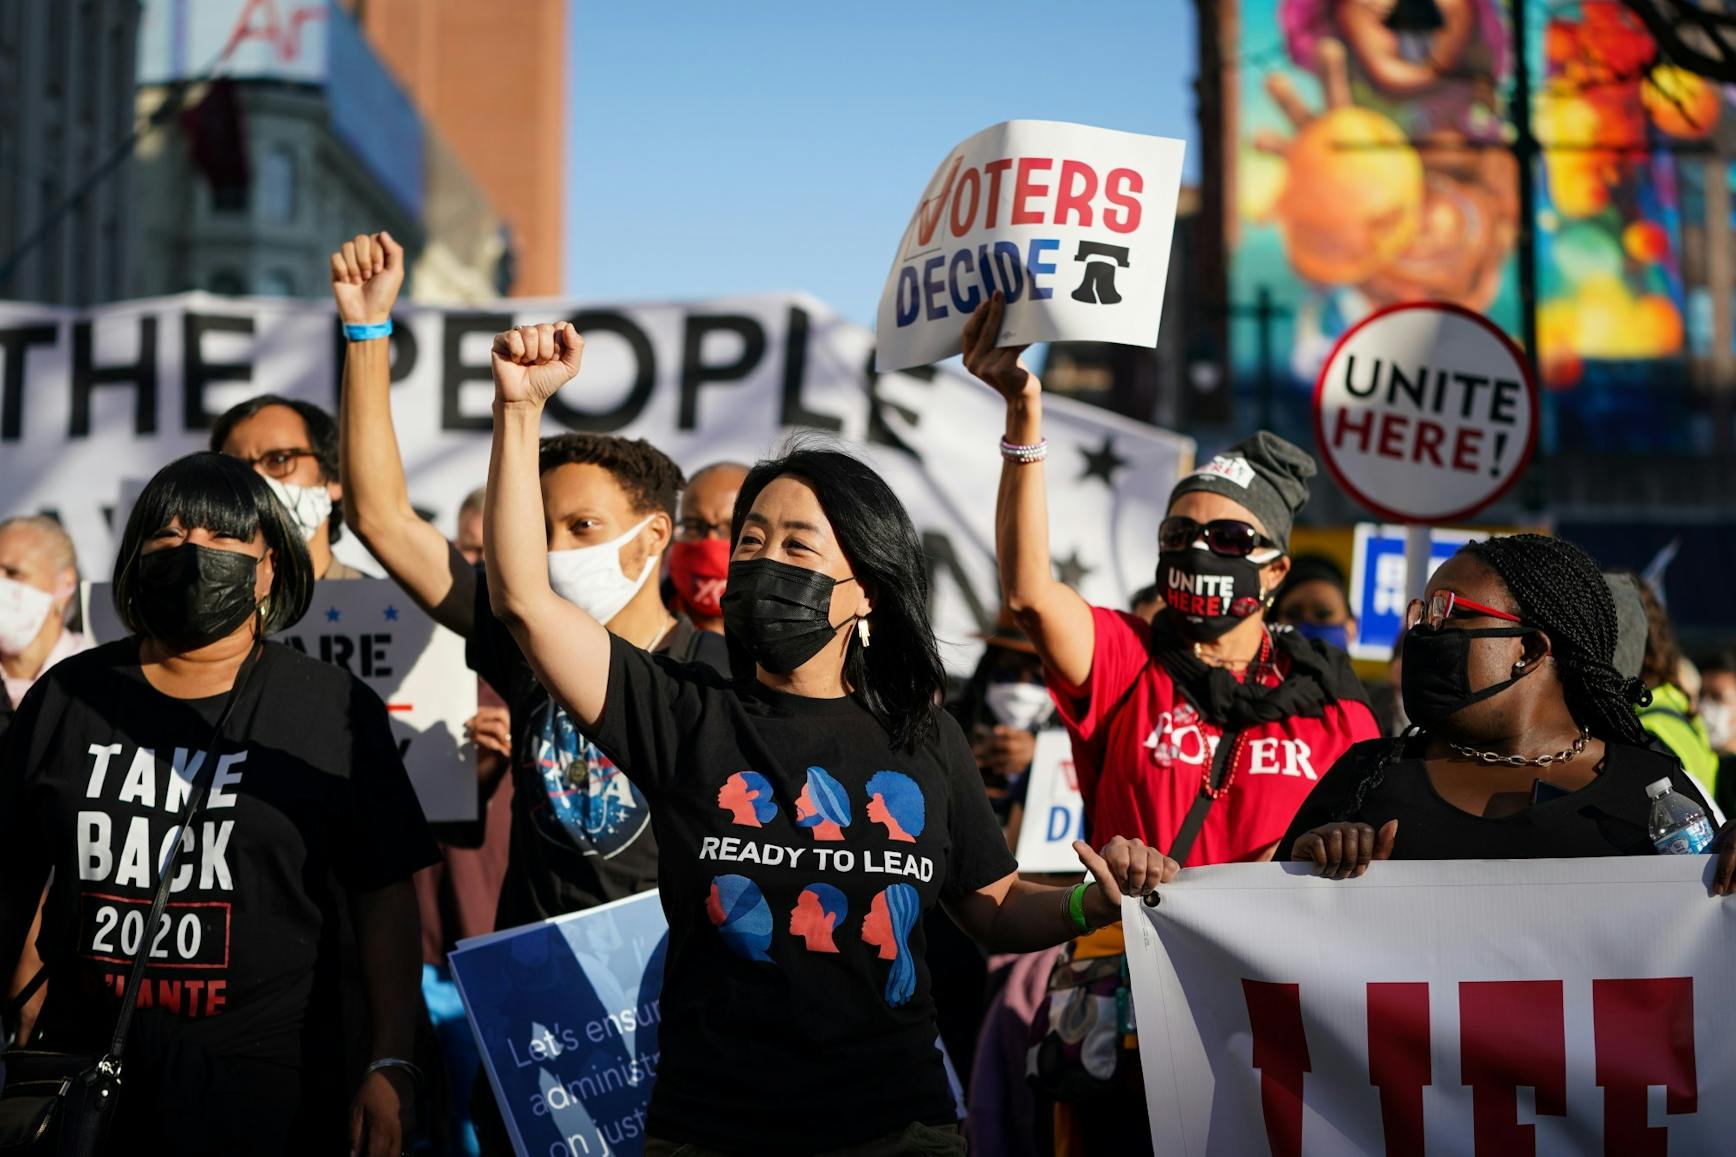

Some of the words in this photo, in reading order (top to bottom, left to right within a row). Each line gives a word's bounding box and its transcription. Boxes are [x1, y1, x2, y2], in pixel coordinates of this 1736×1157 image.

[917, 154, 1144, 247] VOTERS
[896, 239, 1060, 328] DECIDE
[0, 312, 254, 440] THE
[1345, 355, 1521, 426] UNITE
[1333, 407, 1508, 479] HERE!
[1167, 588, 1232, 617] HERE!
[1168, 567, 1235, 598] UNITE
[86, 743, 248, 813] TAKE
[77, 810, 235, 893] BACK
[699, 836, 806, 869] READY
[812, 848, 855, 873] TO
[863, 850, 934, 883] LEAD
[92, 905, 201, 959] 2020
[507, 1022, 579, 1068] Let's
